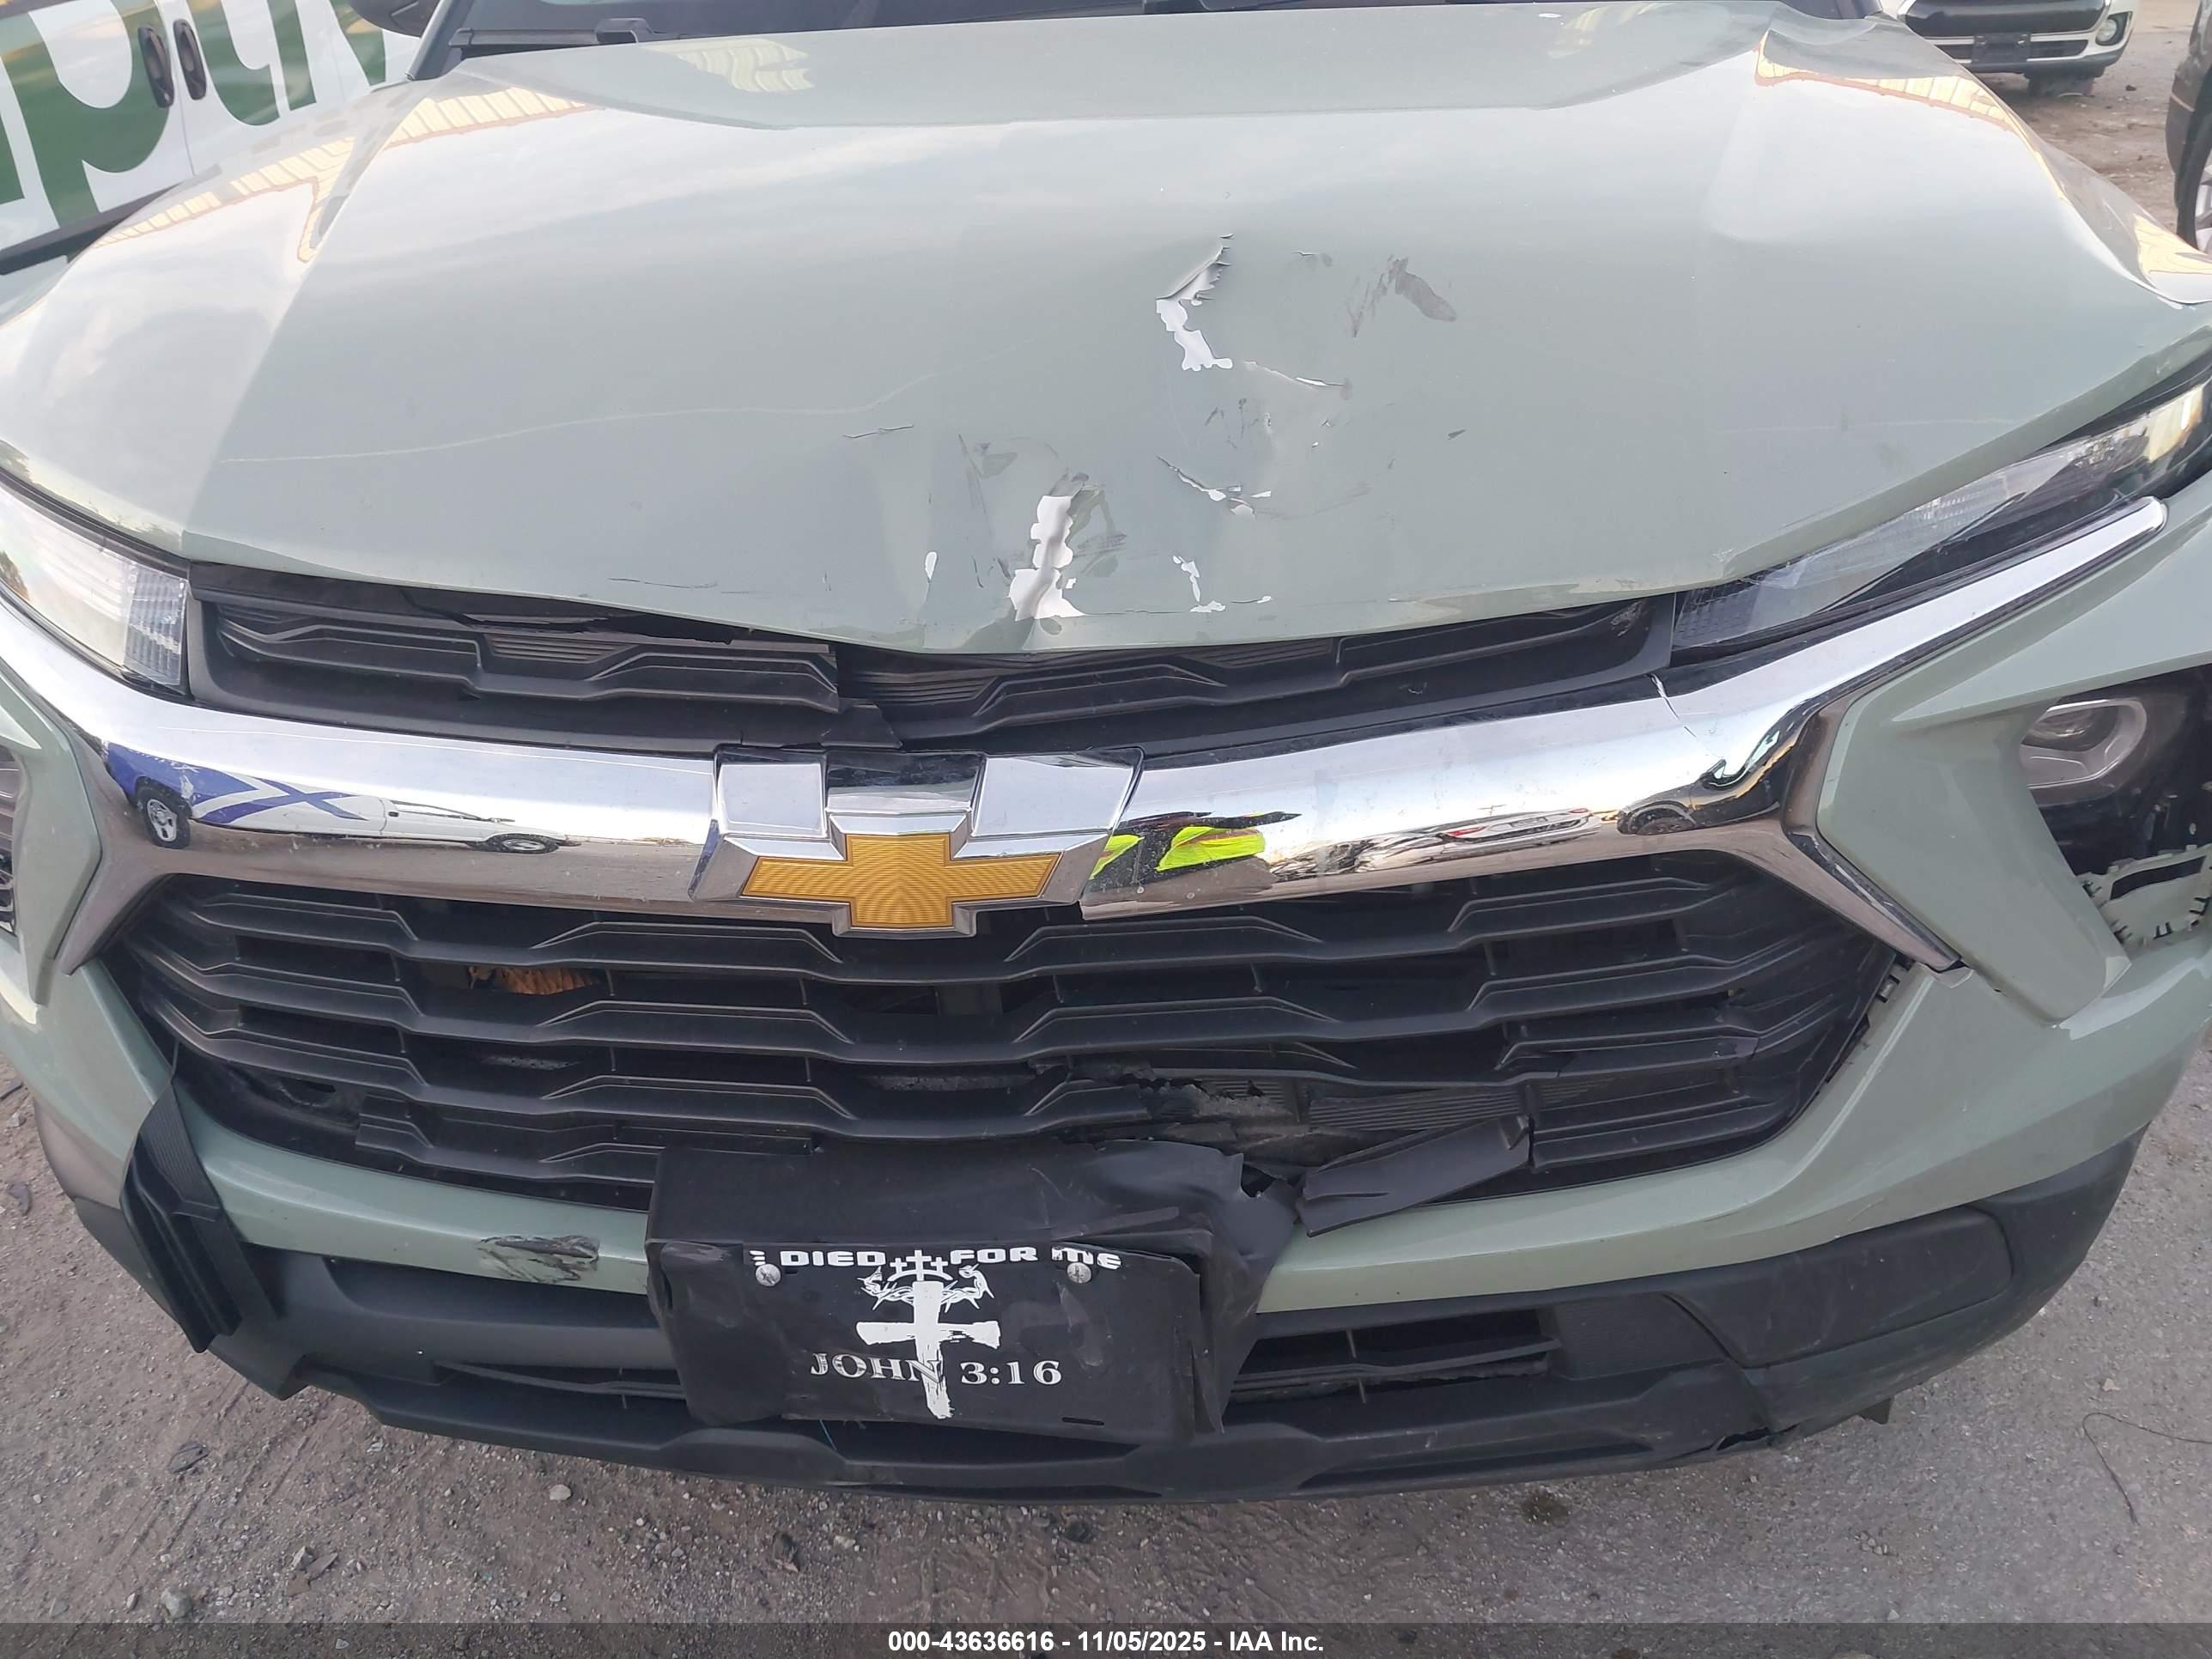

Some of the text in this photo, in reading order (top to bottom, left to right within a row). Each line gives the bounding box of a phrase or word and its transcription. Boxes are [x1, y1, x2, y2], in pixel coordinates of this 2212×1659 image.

[779, 1250, 886, 1267] DIED
[950, 1246, 1038, 1266] FOR
[811, 1352, 1062, 1385] JOHN 3:16
